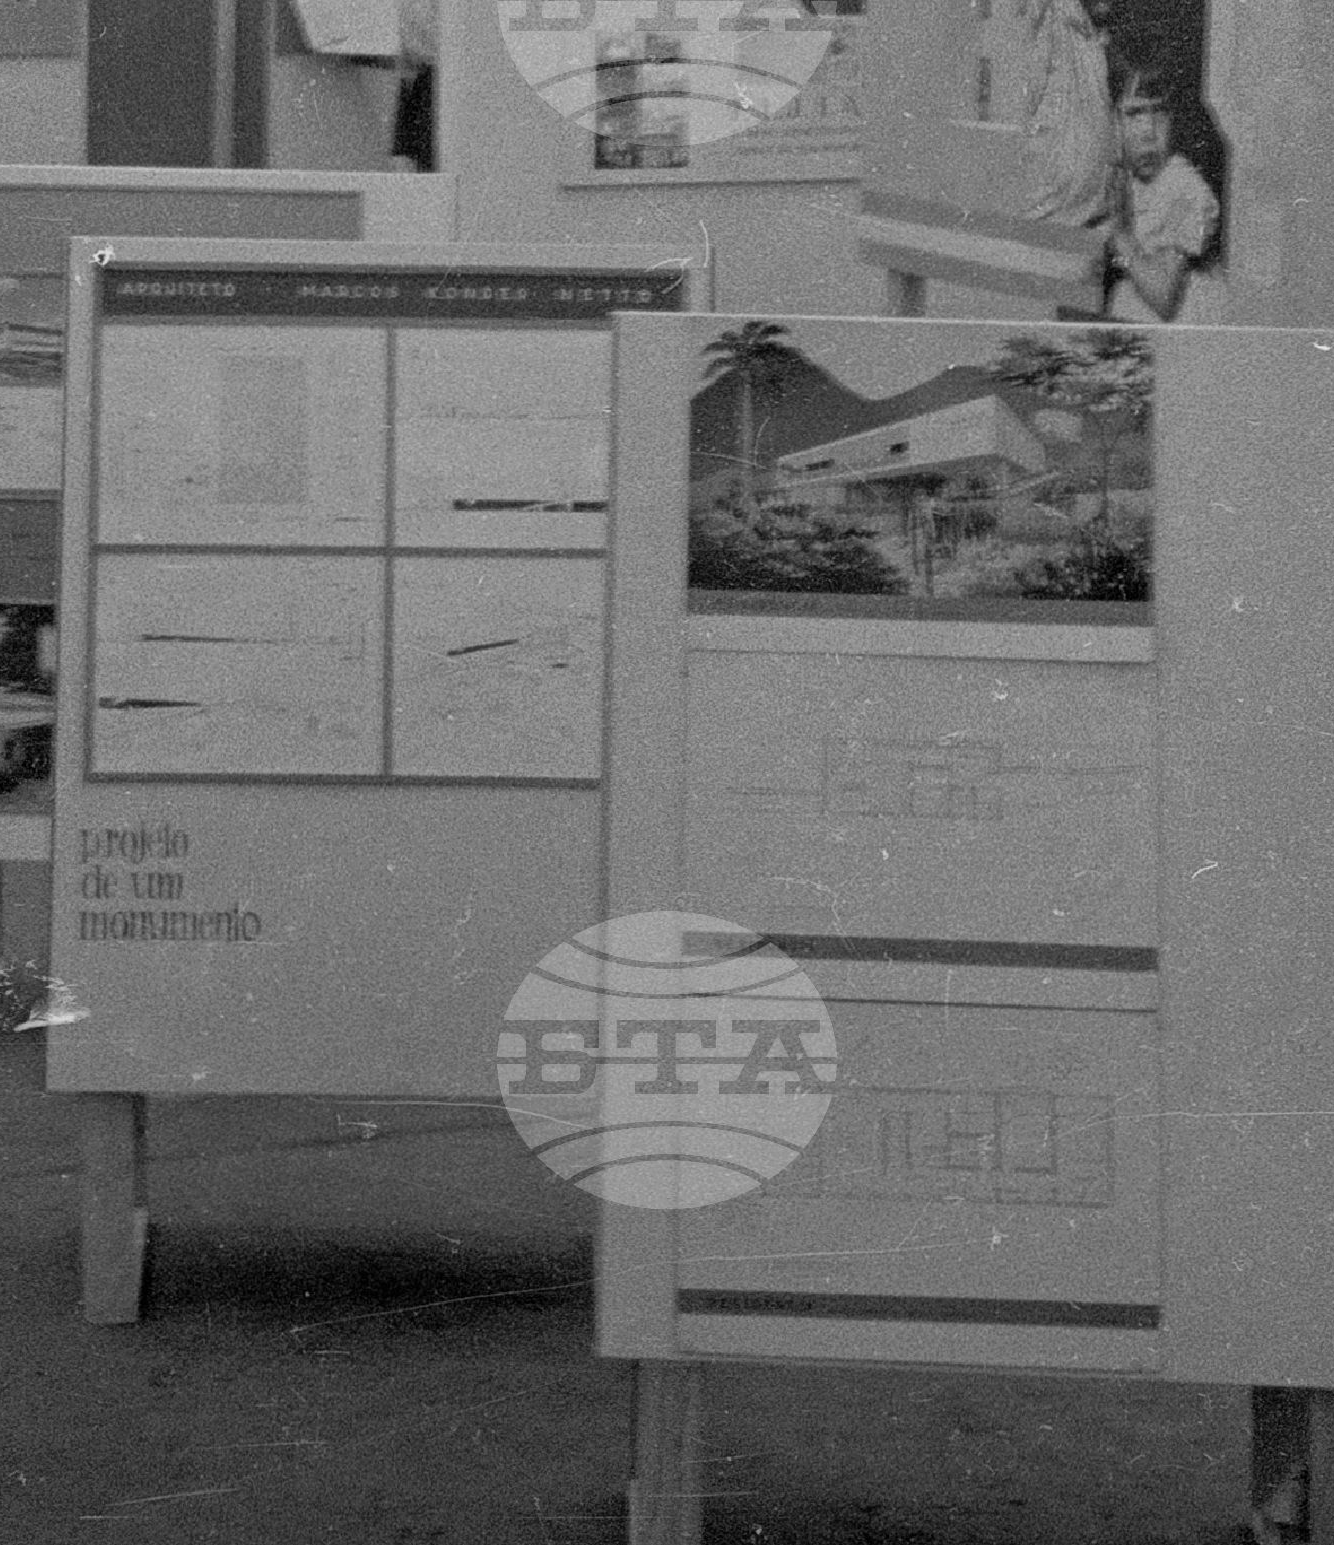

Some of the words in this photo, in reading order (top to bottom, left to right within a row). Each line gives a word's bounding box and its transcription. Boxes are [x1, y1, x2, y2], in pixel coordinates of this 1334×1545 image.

[79, 863, 119, 900] de
[129, 871, 186, 901] um
[78, 905, 263, 942] monumento
